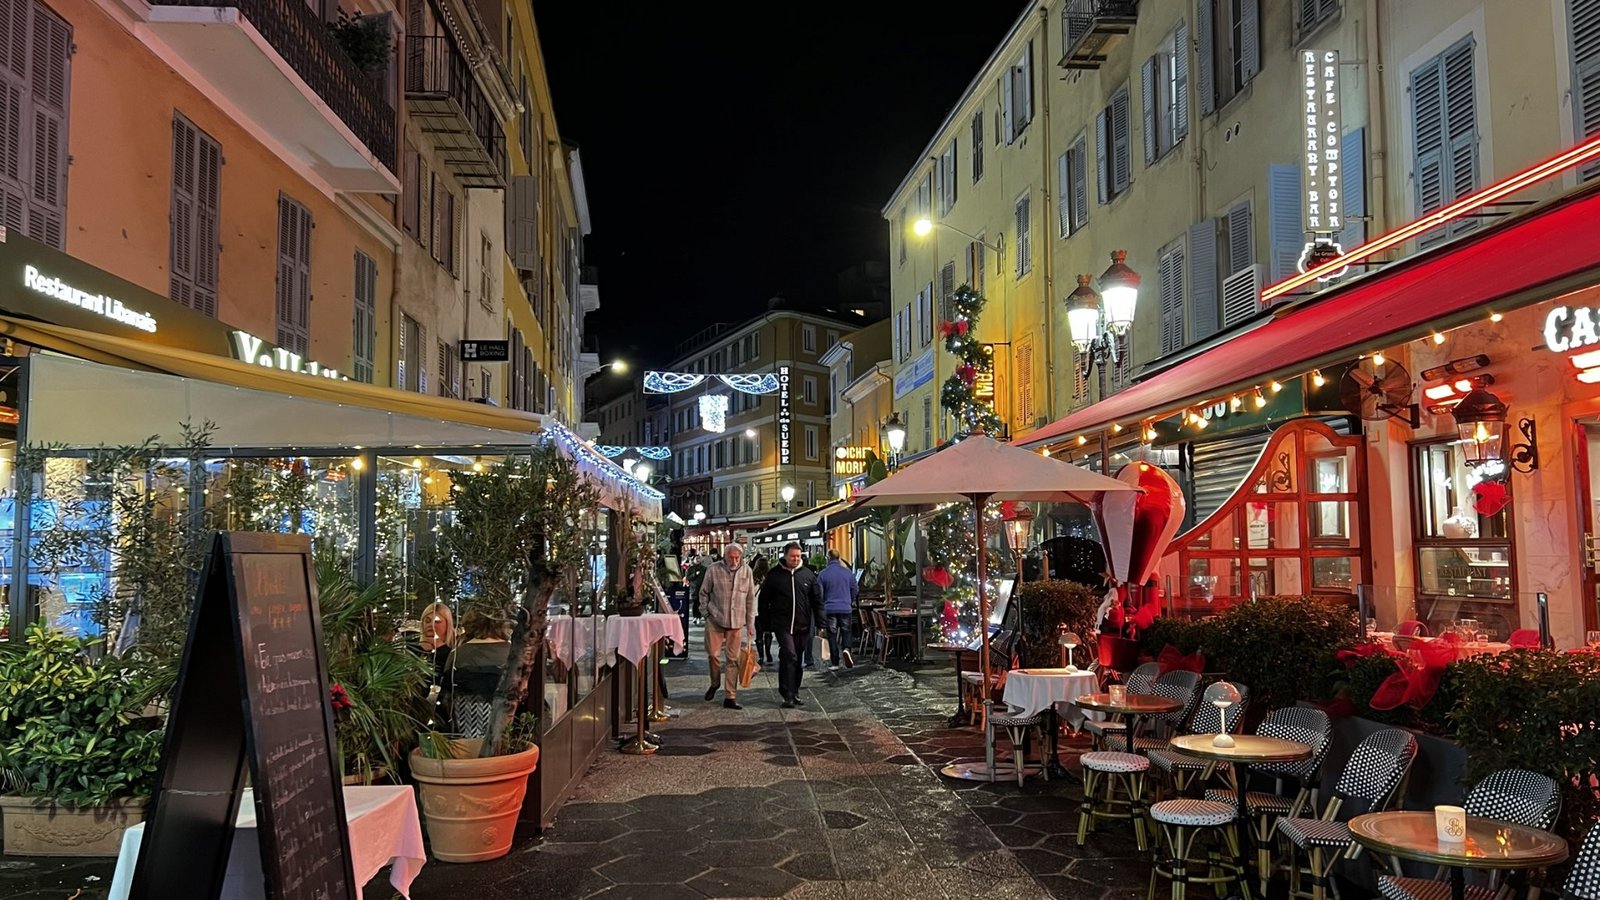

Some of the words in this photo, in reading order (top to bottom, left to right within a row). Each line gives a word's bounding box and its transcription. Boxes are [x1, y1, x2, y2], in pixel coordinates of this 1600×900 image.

[1324, 51, 1336, 104] CAFE
[1304, 51, 1319, 178] RESTAURANT
[1325, 121, 1340, 228] COMPTOIR
[1308, 190, 1320, 228] BAR
[25, 265, 104, 314] Restaurant
[105, 296, 157, 333] Libanais
[1543, 305, 1600, 353] CA
[780, 367, 789, 407] HOTEL
[781, 423, 789, 464] SUEDE
